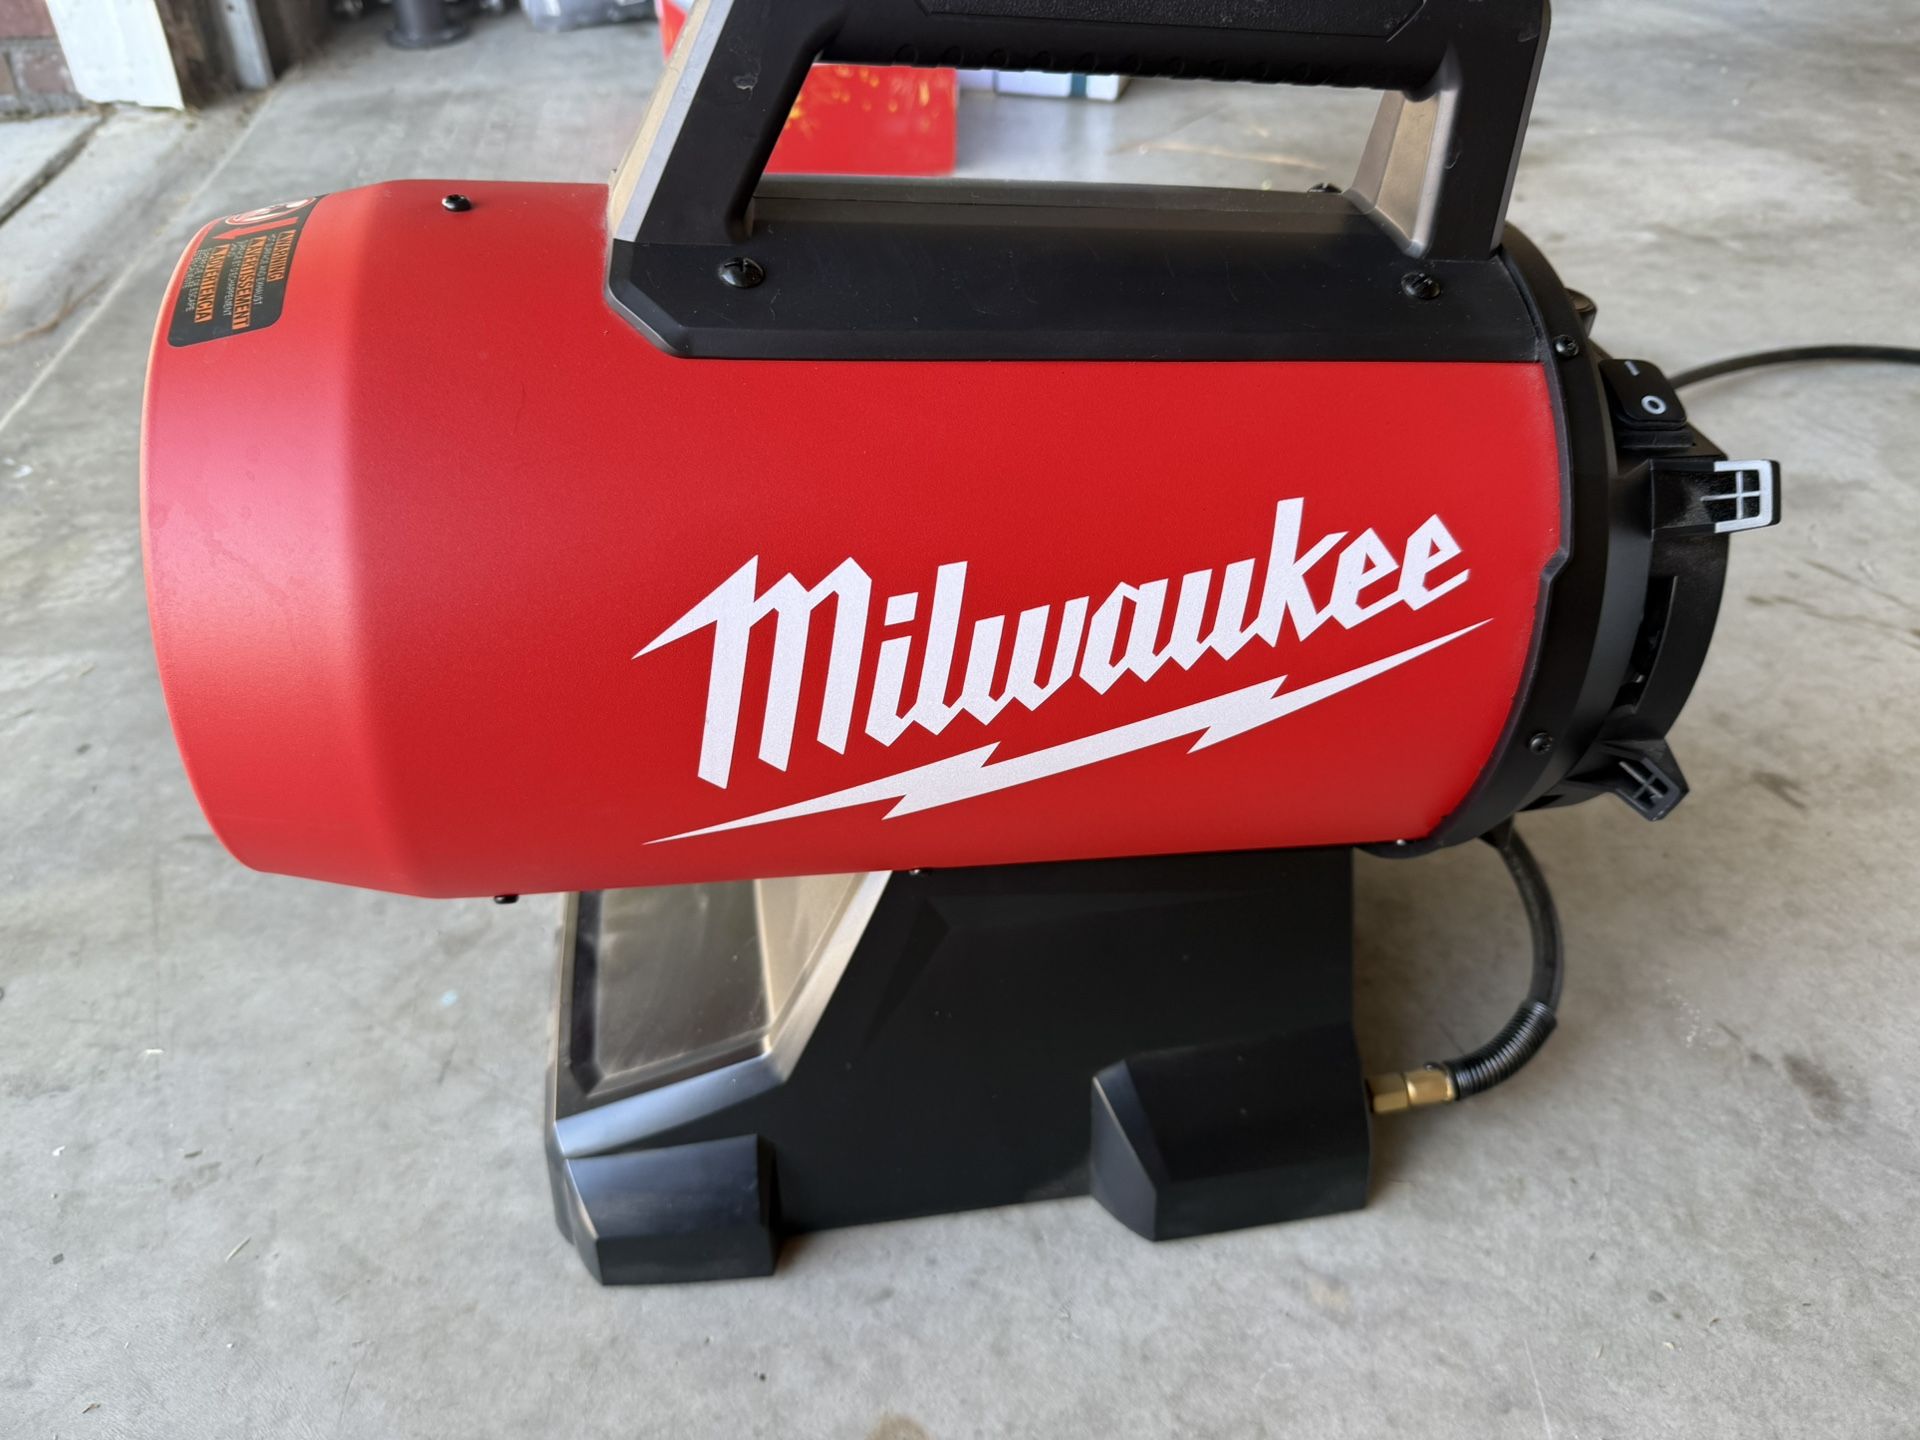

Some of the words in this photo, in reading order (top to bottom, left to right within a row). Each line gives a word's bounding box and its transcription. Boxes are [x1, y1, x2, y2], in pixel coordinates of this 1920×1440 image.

[195, 253, 225, 322] ADVERTENCIA
[232, 245, 263, 328] AVERTISSEMENT
[267, 237, 292, 281] WARNING
[632, 497, 1470, 789] Milwaukee
